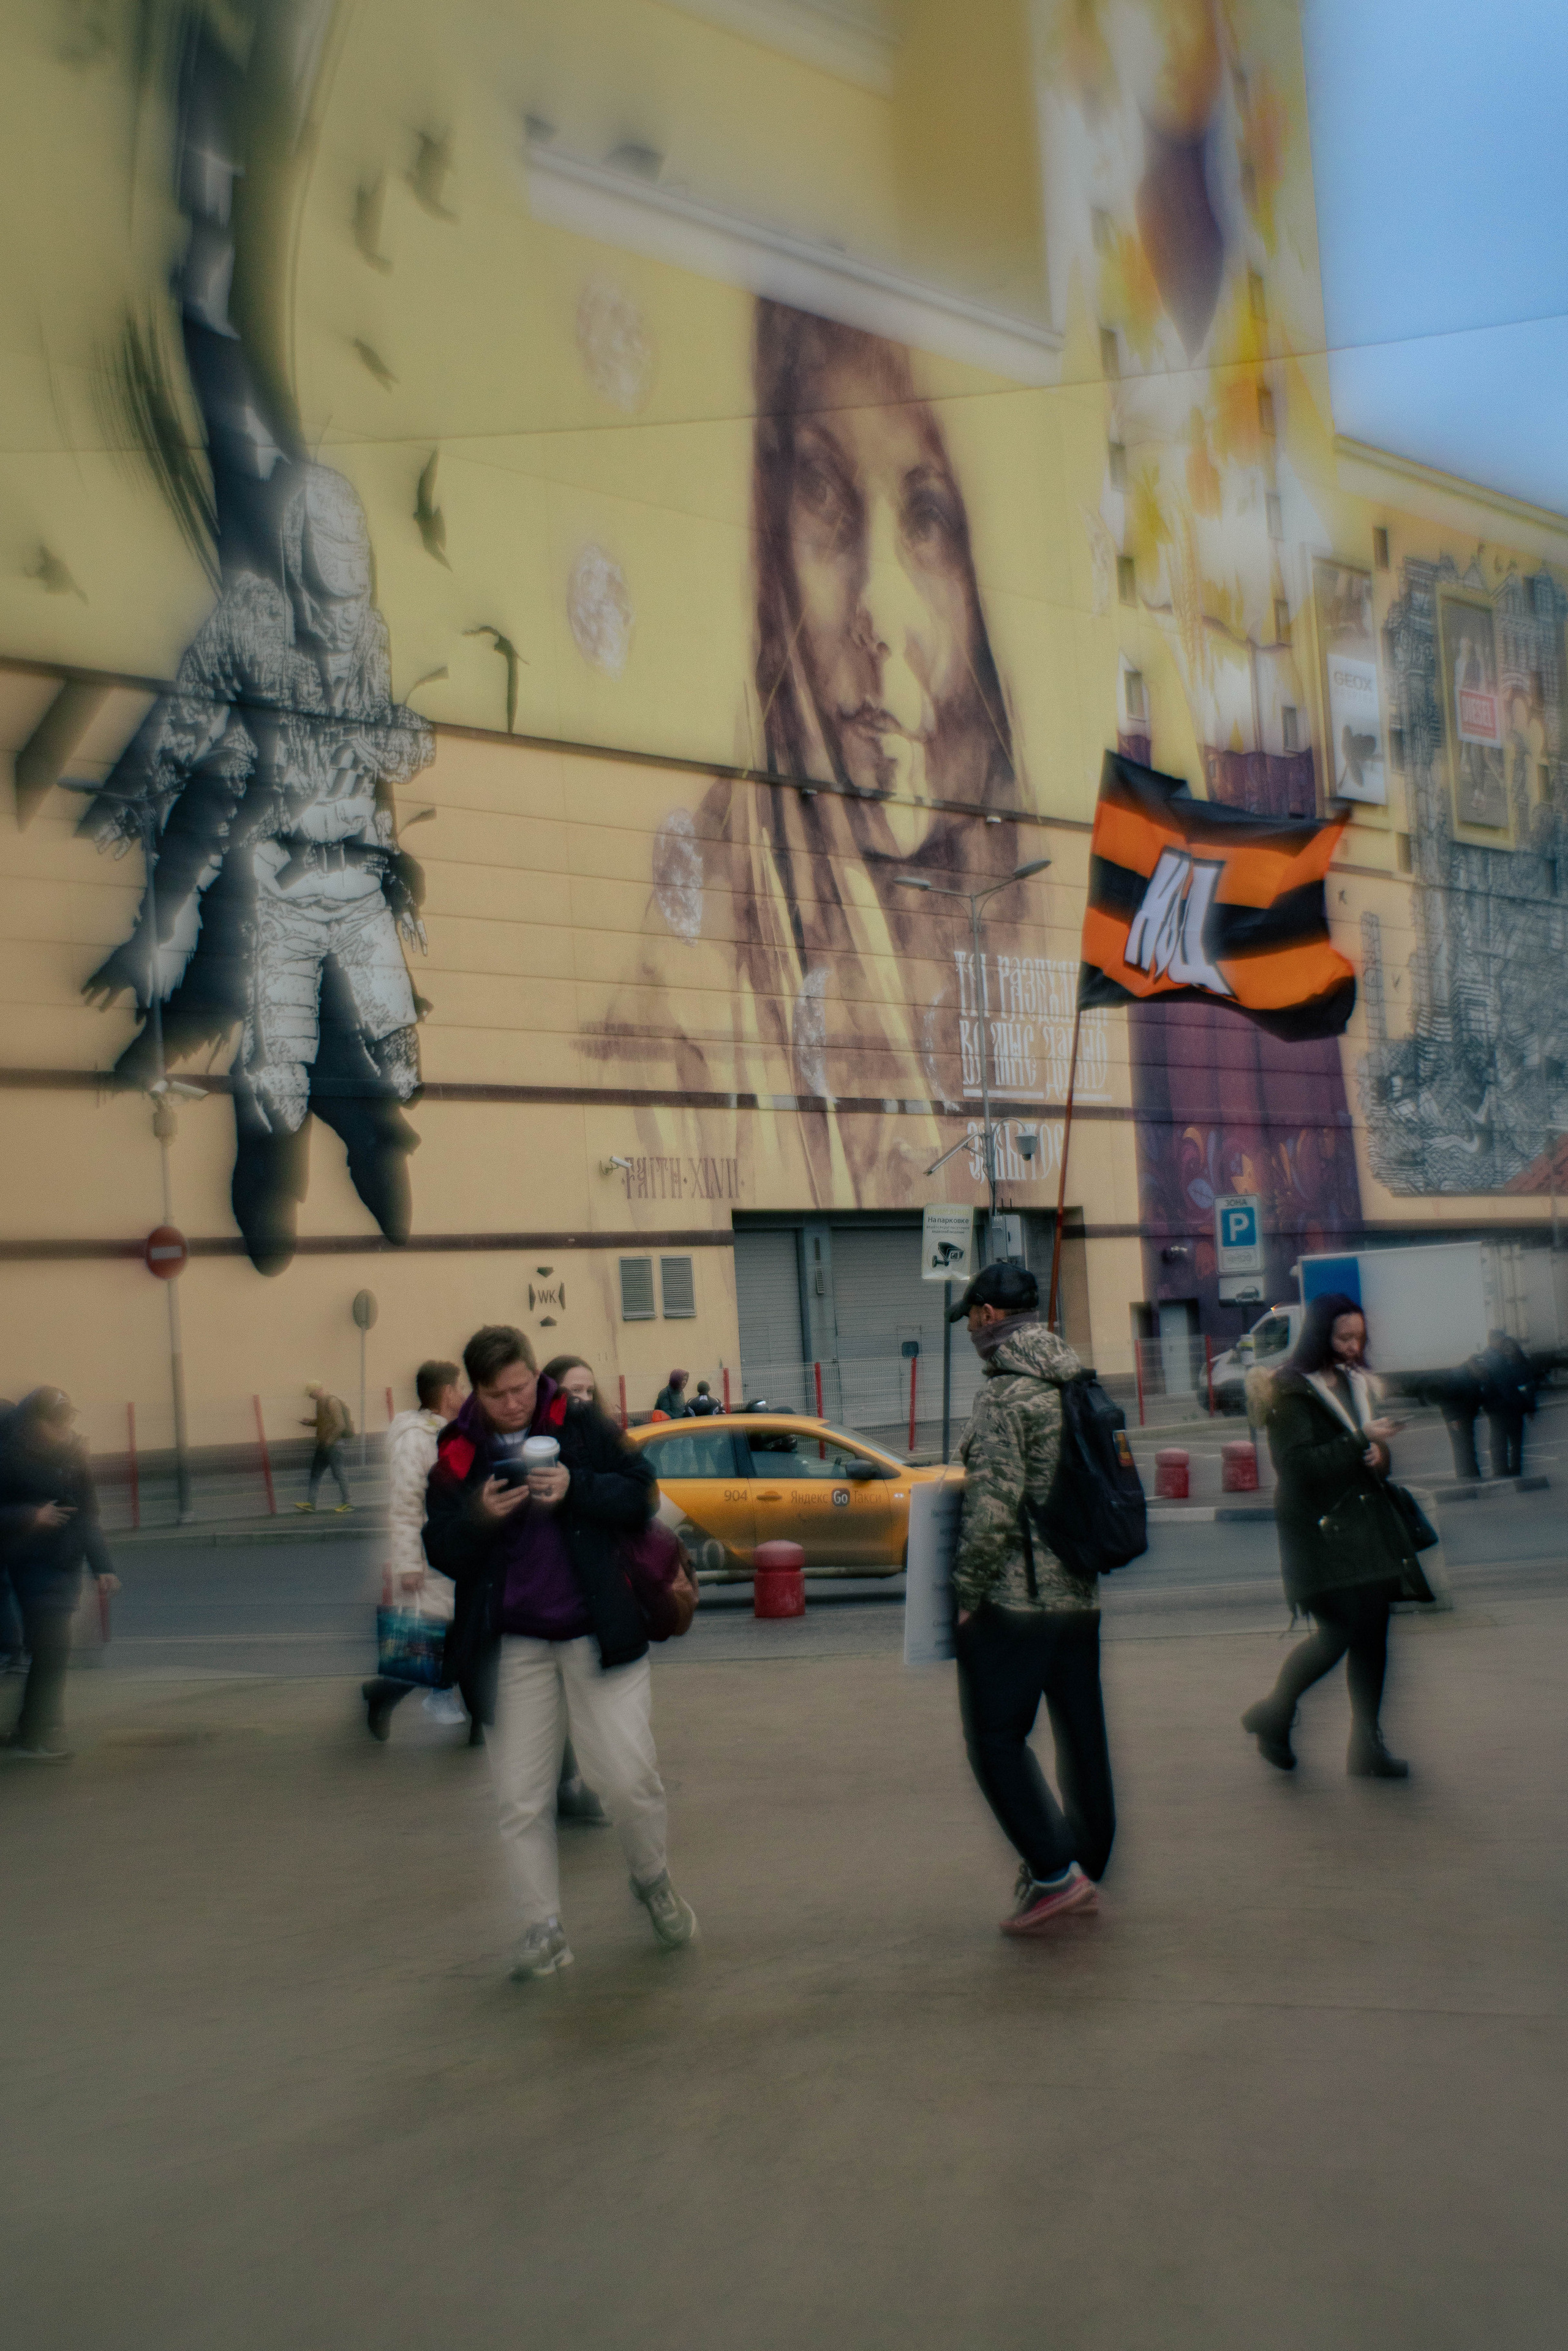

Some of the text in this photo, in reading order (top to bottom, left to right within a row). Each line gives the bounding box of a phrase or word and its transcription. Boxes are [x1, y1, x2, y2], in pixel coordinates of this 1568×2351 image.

[1333, 670, 1373, 692] GEOX
[1225, 1198, 1248, 1207] ЗОНА
[1229, 1213, 1250, 1242] P
[538, 1289, 557, 1304] WK
[724, 1489, 748, 1501] 904
[790, 1490, 881, 1504] Яндекс Go Такси
